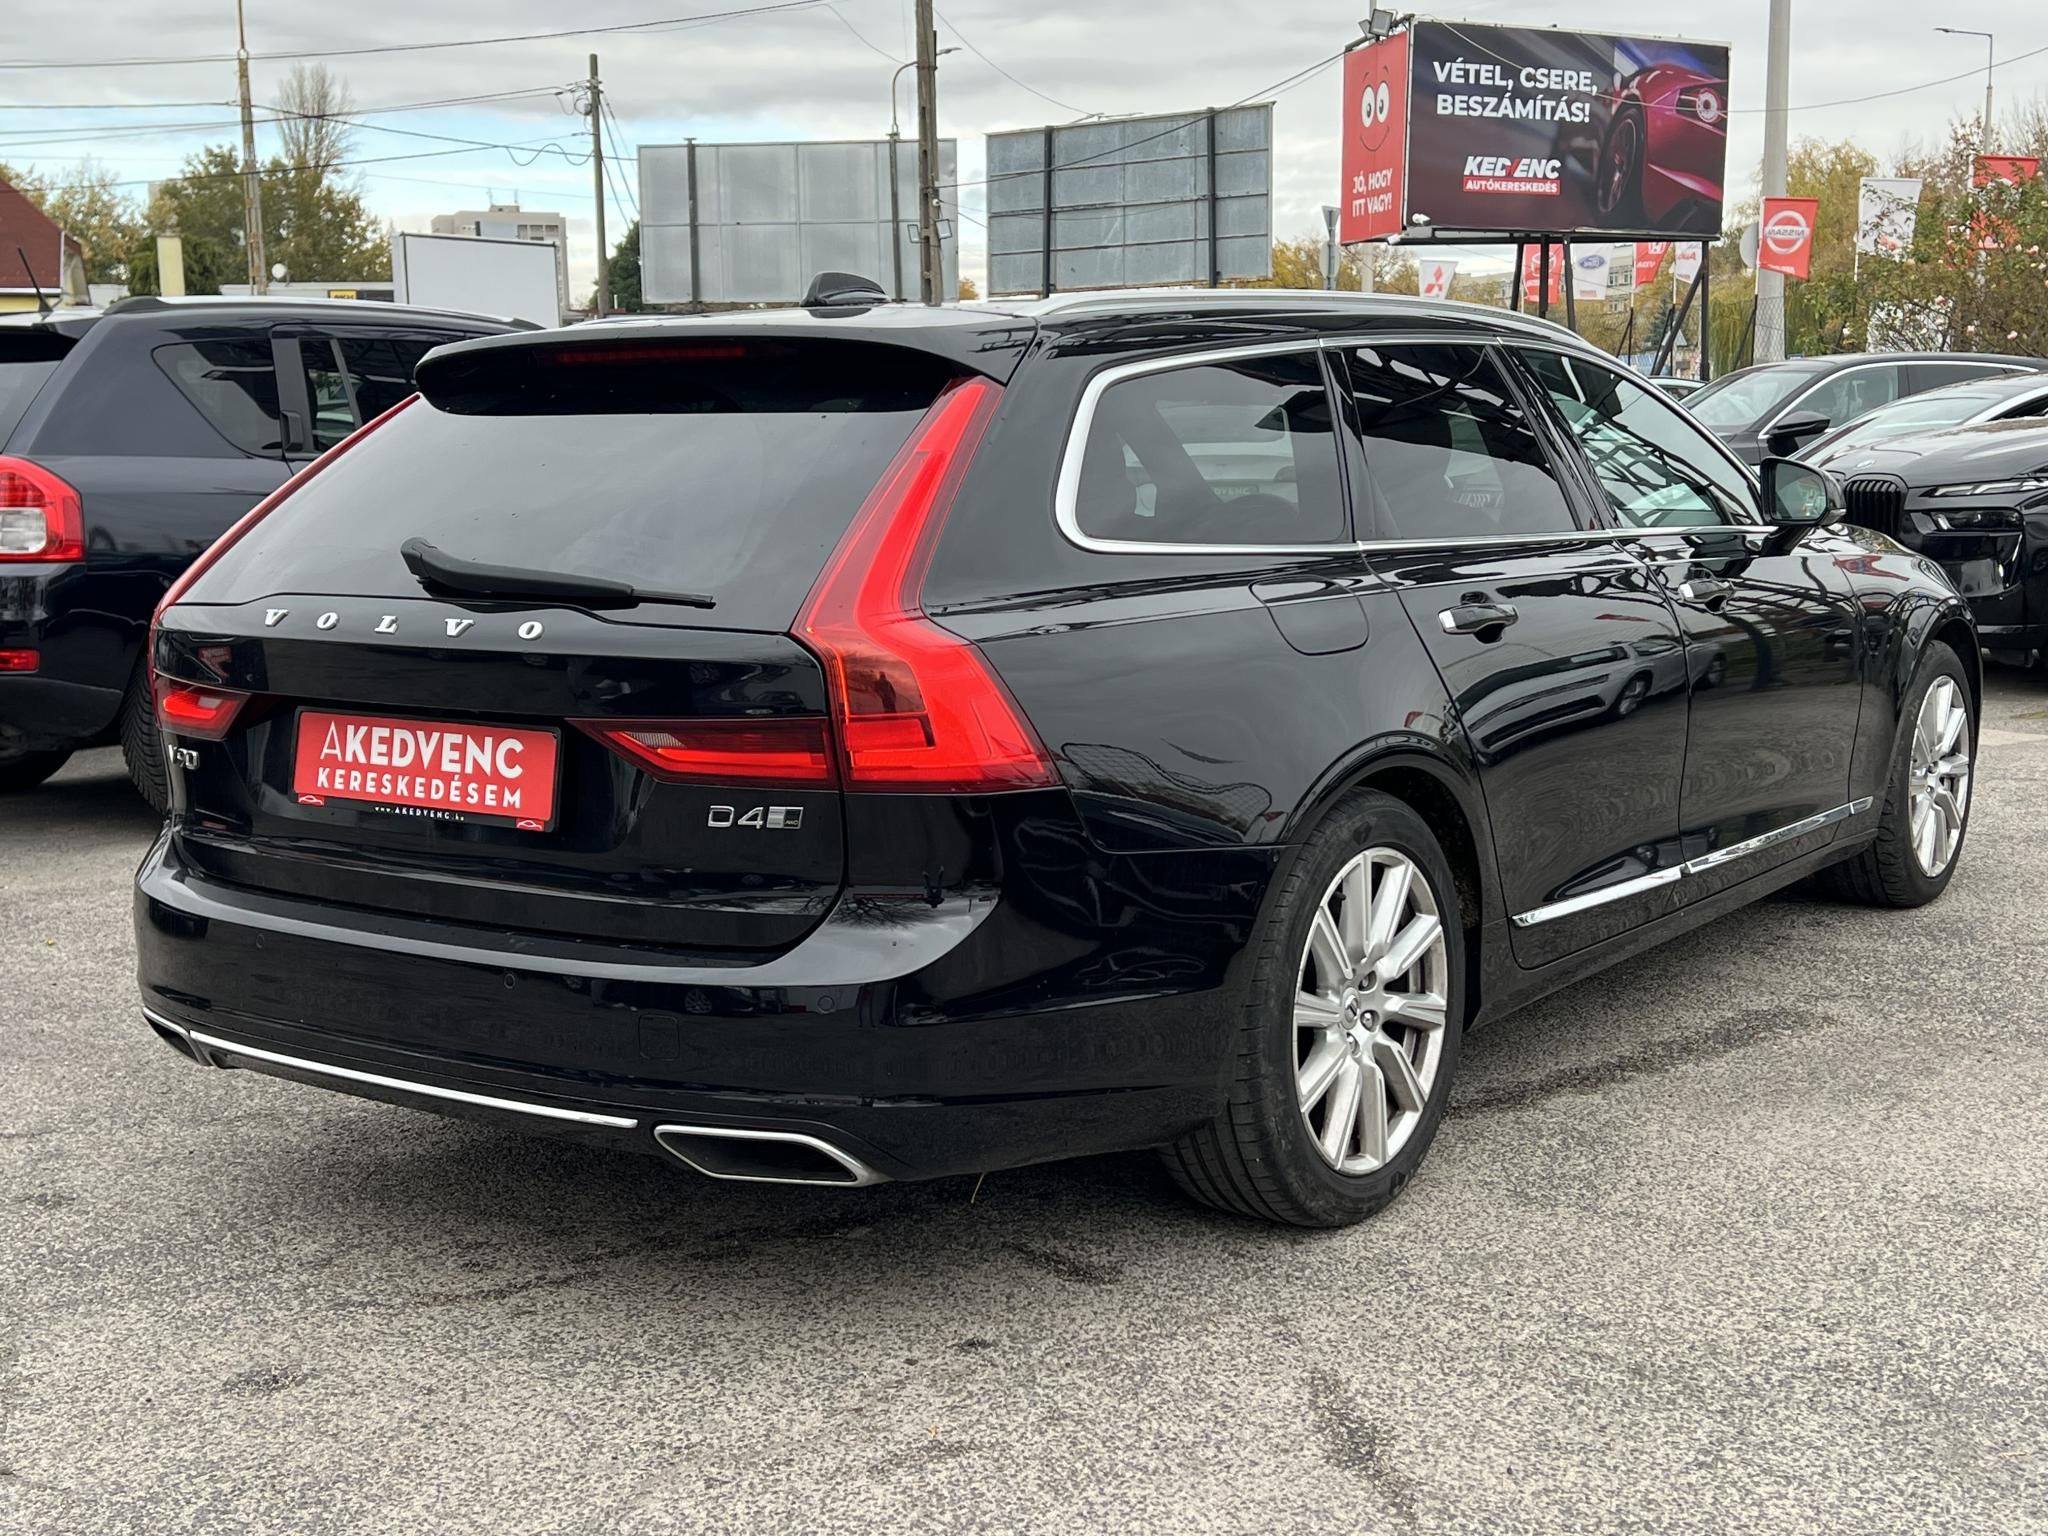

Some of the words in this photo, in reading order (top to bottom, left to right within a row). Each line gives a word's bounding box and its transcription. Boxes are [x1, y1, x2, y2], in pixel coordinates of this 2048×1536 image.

[1433, 57, 1514, 91] VÉTEL,
[1520, 67, 1598, 96] CSERE,
[1437, 92, 1591, 123] BESZÁMÍTÁS!
[1464, 156, 1562, 179] KEDVENC
[1352, 170, 1367, 195] JÓ,
[1368, 168, 1393, 191] HOGY
[1466, 179, 1558, 193] AUTÓKERESKEDÉS
[1352, 198, 1366, 217] ITT
[1367, 192, 1392, 215] VAGY!
[264, 608, 544, 641] VOLVO
[317, 766, 521, 809] KERESKEDÉSEM
[707, 805, 764, 829] D4
